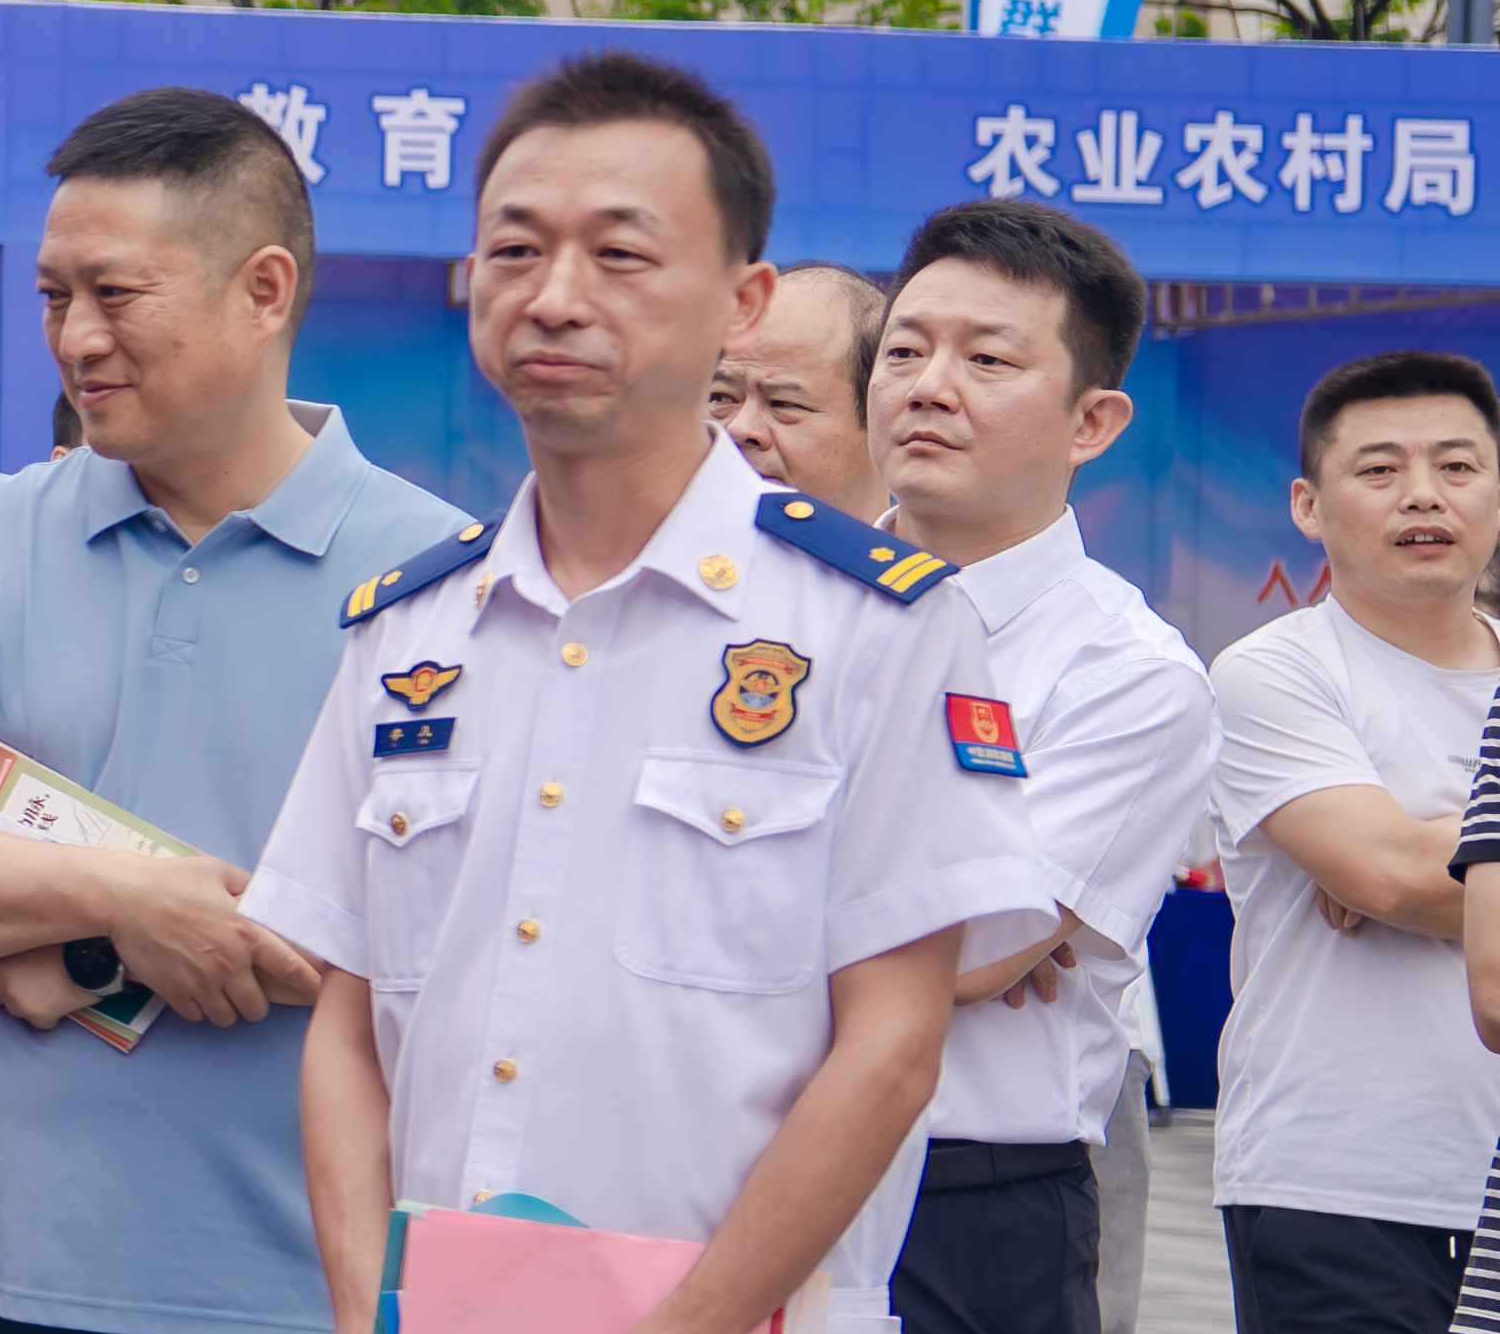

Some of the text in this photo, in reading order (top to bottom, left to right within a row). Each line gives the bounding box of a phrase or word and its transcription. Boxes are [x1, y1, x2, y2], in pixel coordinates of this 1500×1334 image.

[968, 104, 1477, 217] 农业农村局
